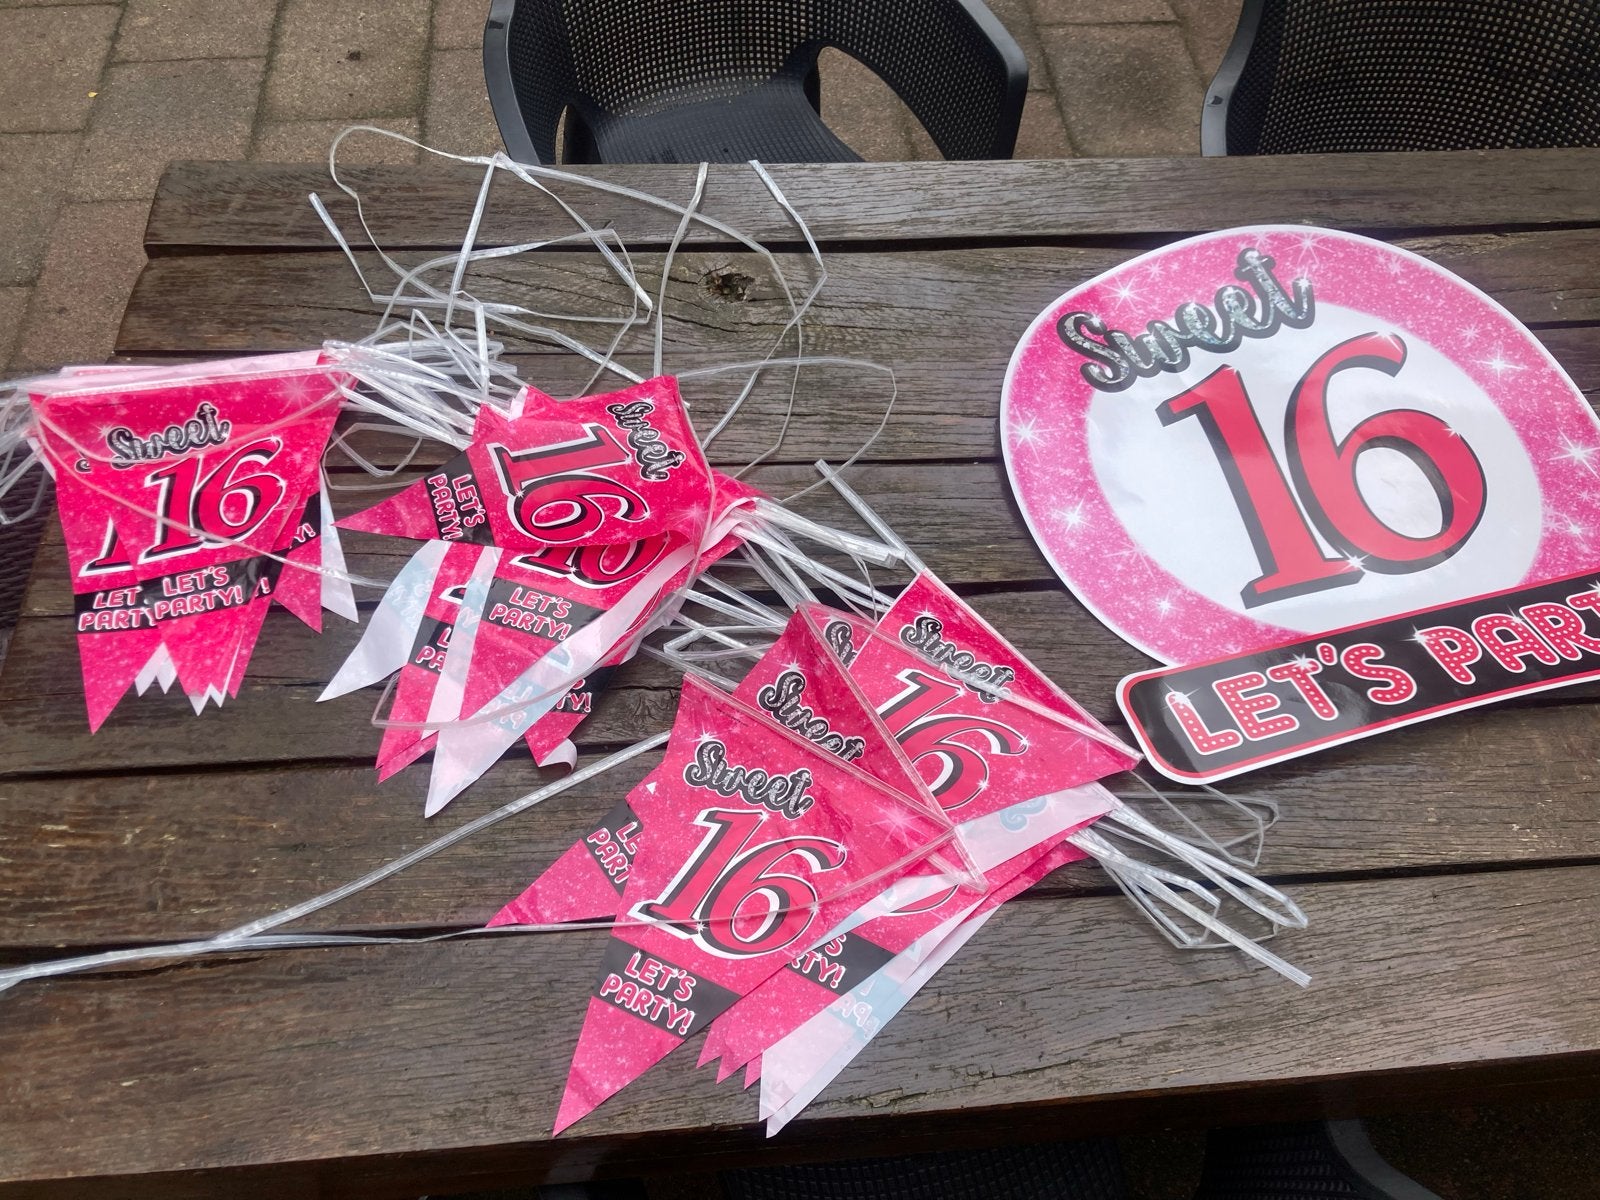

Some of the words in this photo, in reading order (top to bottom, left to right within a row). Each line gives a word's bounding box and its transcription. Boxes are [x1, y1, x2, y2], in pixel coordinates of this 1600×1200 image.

[1056, 247, 1315, 393] Sweet
[107, 401, 232, 469] Sweet
[605, 400, 687, 482] Sweet
[1155, 331, 1488, 610] 16
[138, 437, 287, 565] 16
[427, 472, 465, 541] PARTY!
[452, 473, 486, 531] LET'S
[486, 421, 652, 544] 16
[92, 586, 142, 609] LET
[154, 585, 243, 621] PARTY!
[163, 565, 231, 597] LET'S
[508, 586, 572, 619] LET'S
[489, 603, 572, 640] PARTY!
[899, 614, 1016, 704] Sweet
[1166, 642, 1417, 755] LET'S
[876, 667, 1030, 813] 16
[682, 740, 816, 820] Sweet
[625, 806, 848, 960] 16
[600, 975, 696, 1036] PARTY!
[623, 951, 696, 1001] LET'S
